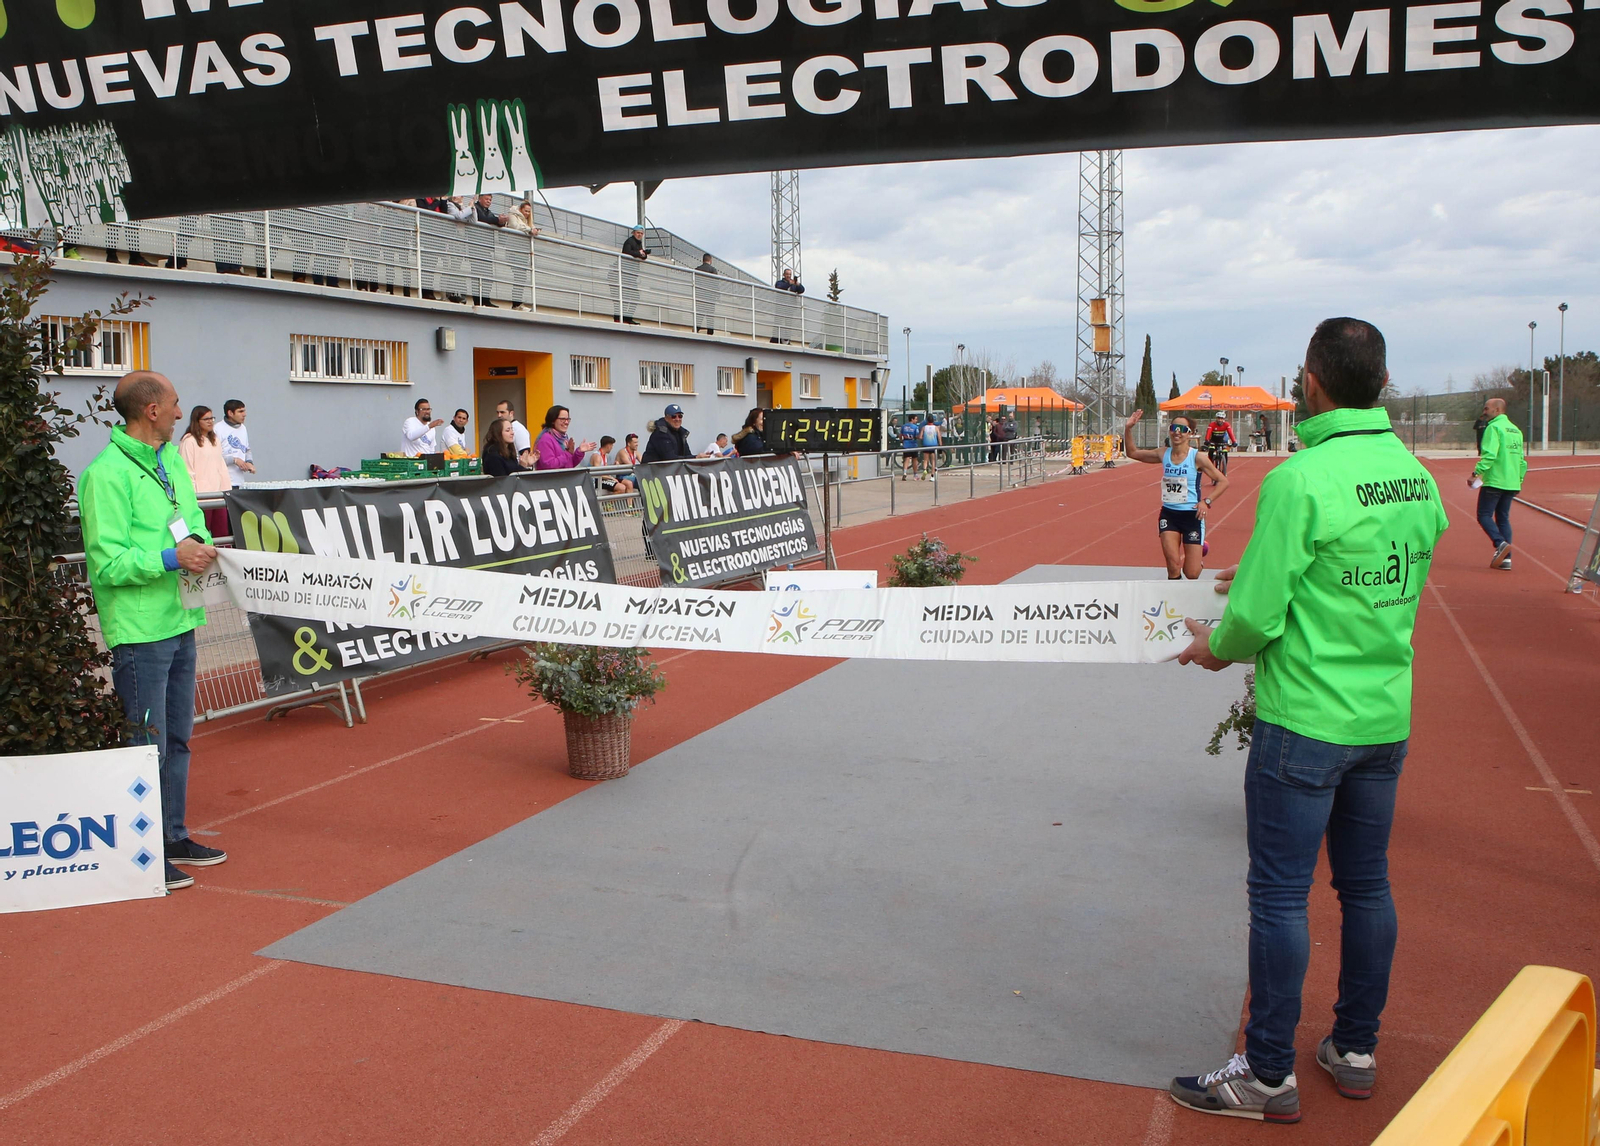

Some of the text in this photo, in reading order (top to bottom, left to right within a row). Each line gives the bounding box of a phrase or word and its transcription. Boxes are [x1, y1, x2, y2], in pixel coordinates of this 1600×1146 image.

[0, 33, 291, 117] NUEVAS
[596, 0, 1600, 132] ELECTRODOMES
[780, 418, 873, 443] 1:24:03
[1164, 467, 1188, 476] nerja
[666, 464, 804, 522] MILAR LUCENA
[1165, 483, 1183, 493] 542
[460, 485, 599, 556] LUCENA
[679, 517, 805, 558] NUEVAS TECNOLOGÍAS
[687, 537, 809, 581] ELECTRODOMESTICOS
[243, 566, 290, 584] MEDIA
[301, 571, 373, 591] MARATÓN
[245, 587, 368, 612] CIUDAD DE LUCENA
[429, 596, 484, 613] PDM
[518, 584, 602, 611] MEDIA
[922, 598, 1120, 622] MEDIA MARATÓN
[422, 608, 473, 620] Lucena
[818, 618, 885, 632] PDM
[512, 614, 597, 637] CIUDAD
[603, 622, 637, 640] DE
[811, 631, 874, 641] Lucena
[919, 629, 1117, 645] CIUDAD DE LUCENA
[4, 862, 100, 880] y plantas
